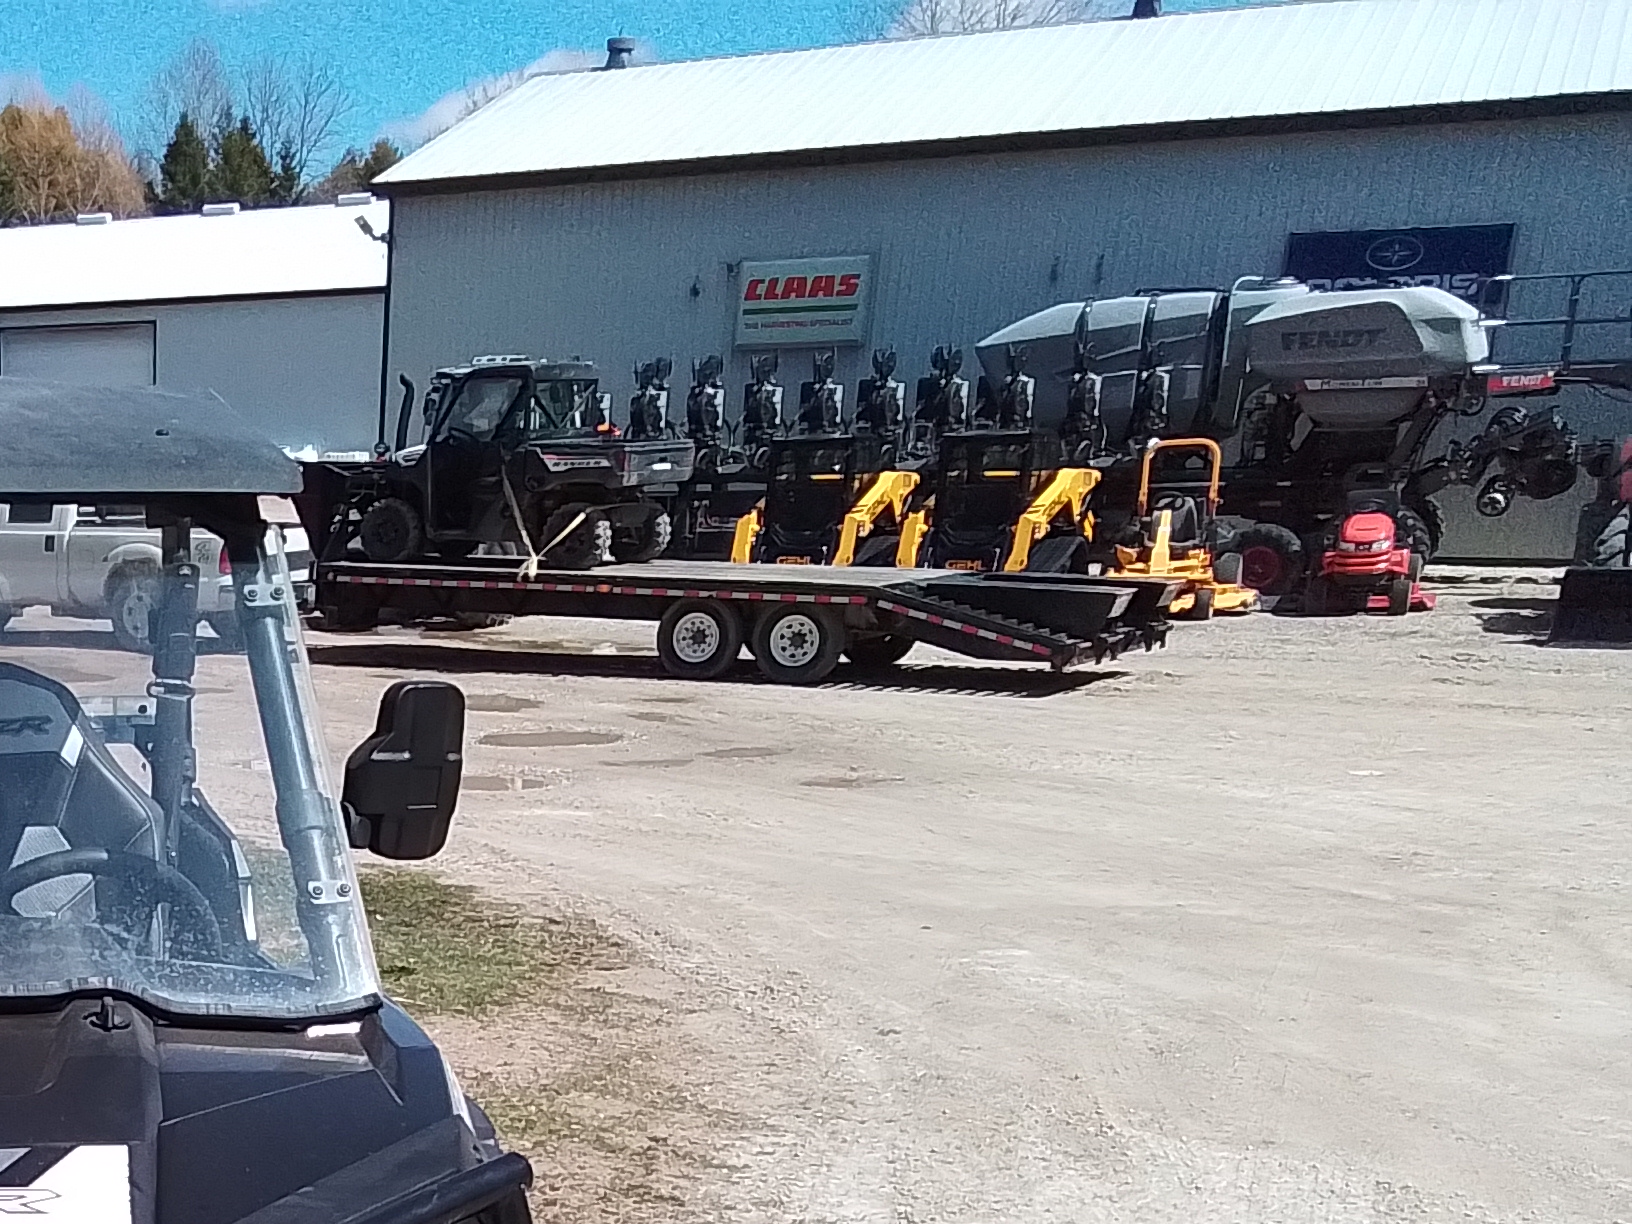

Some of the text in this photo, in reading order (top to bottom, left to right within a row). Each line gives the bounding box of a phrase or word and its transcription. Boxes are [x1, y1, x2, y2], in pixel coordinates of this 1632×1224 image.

[743, 273, 861, 301] CLAAS
[776, 556, 813, 566] GEHL
[945, 559, 988, 571] GEHL
